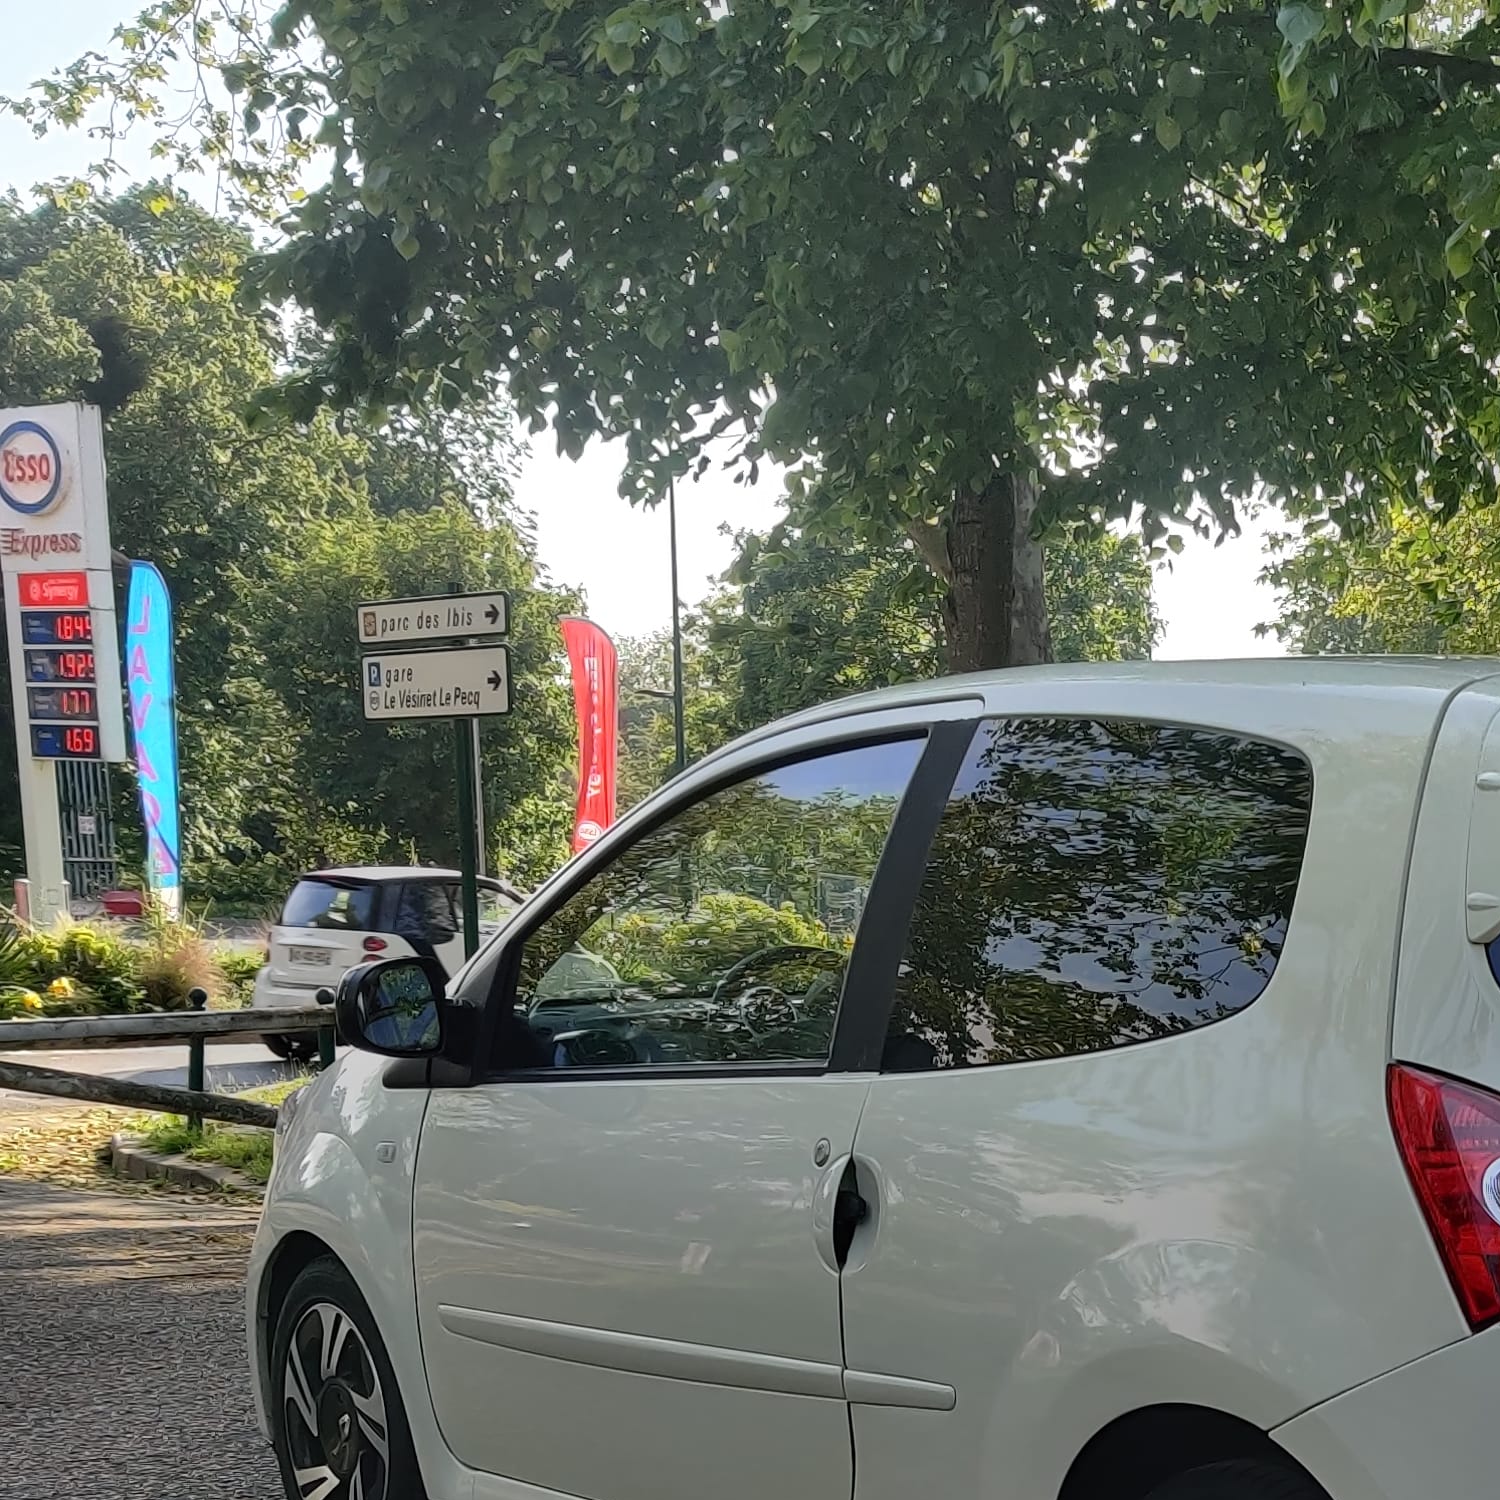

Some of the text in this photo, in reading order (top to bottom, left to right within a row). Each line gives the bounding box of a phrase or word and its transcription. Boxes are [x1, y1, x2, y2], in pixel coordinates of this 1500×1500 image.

[10, 527, 81, 560] Express
[381, 606, 473, 637] parc des Ibis
[385, 667, 413, 688] gare
[384, 687, 480, 710] Le Vésinet Le Pecq
